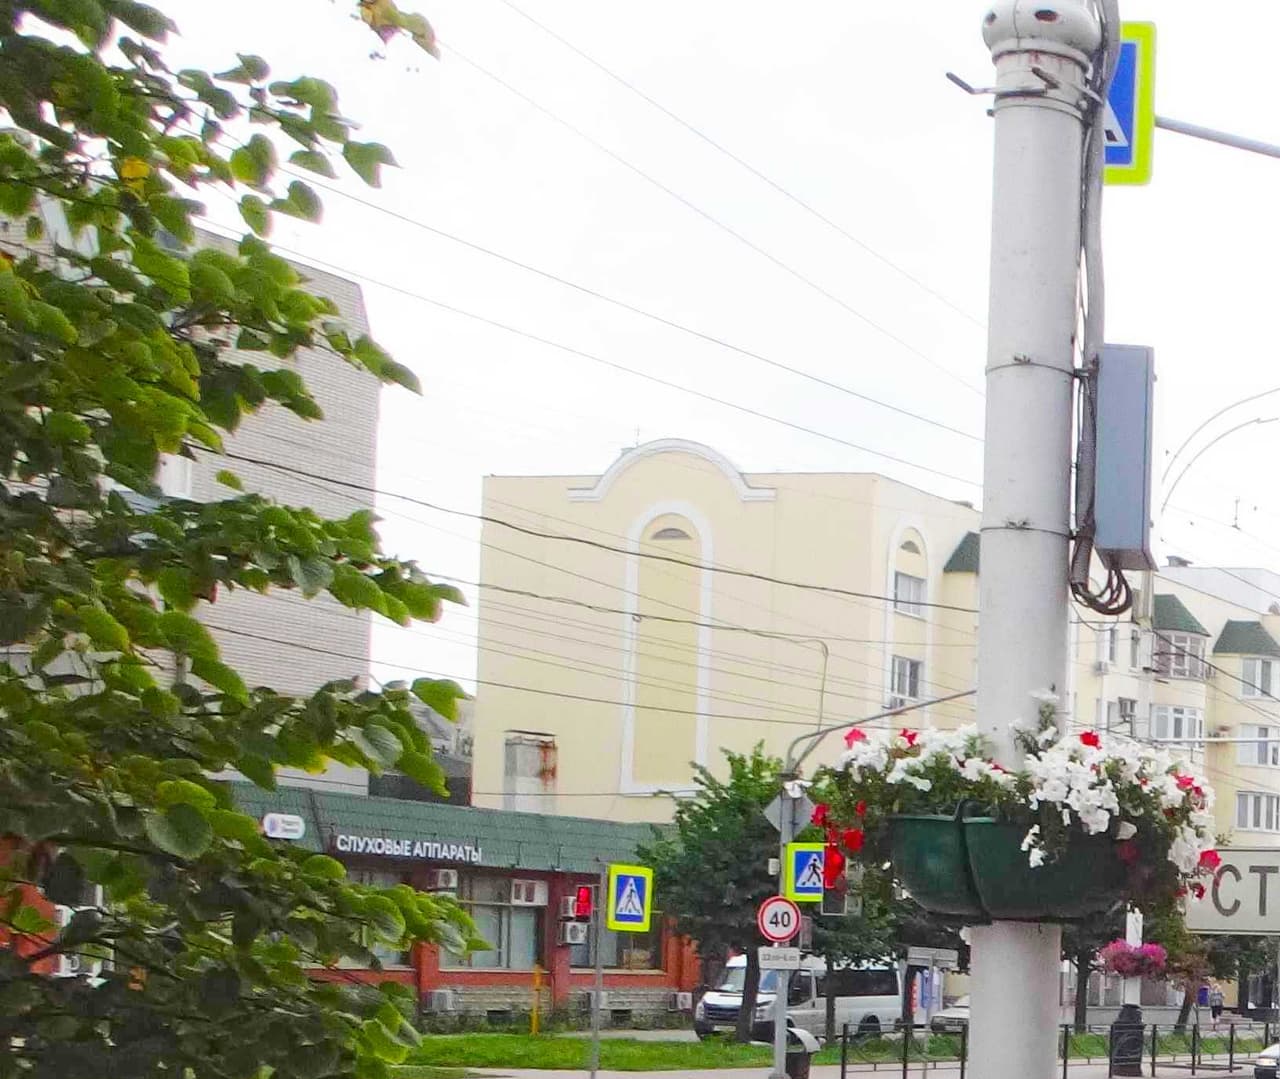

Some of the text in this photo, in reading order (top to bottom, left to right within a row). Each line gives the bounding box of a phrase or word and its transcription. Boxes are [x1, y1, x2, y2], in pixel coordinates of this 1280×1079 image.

[336, 834, 482, 863] СЛУХОВЫЕ АППАРАТЫ
[768, 911, 791, 928] 40
